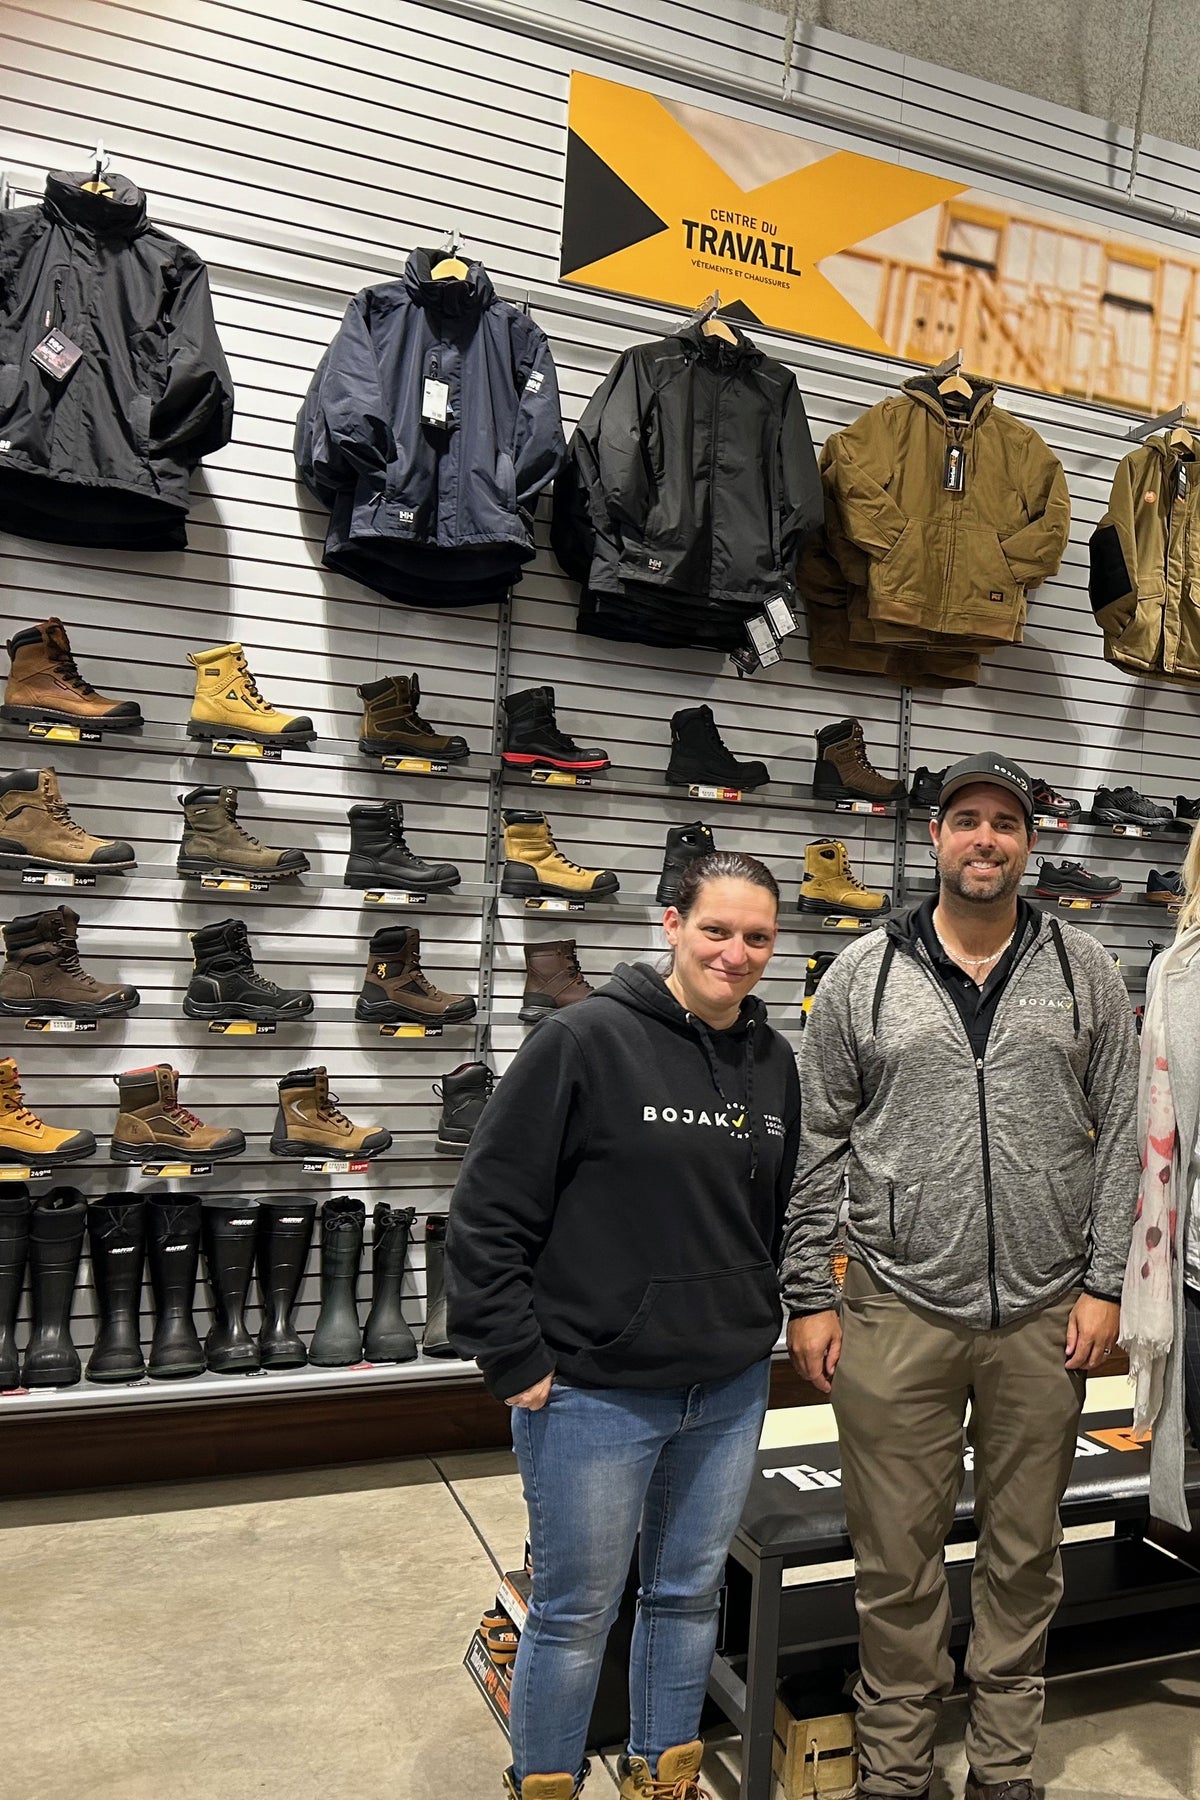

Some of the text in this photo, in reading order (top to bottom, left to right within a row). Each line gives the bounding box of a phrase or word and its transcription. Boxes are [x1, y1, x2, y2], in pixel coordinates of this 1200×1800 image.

[710, 208, 778, 236] CENTRE DU
[681, 218, 801, 277] TRAVAIL
[691, 258, 733, 275] VÊTEMENTS
[744, 272, 791, 289] CHAUSSURES
[1019, 998, 1064, 1008] BOJAK
[643, 1106, 730, 1127] BOJAK
